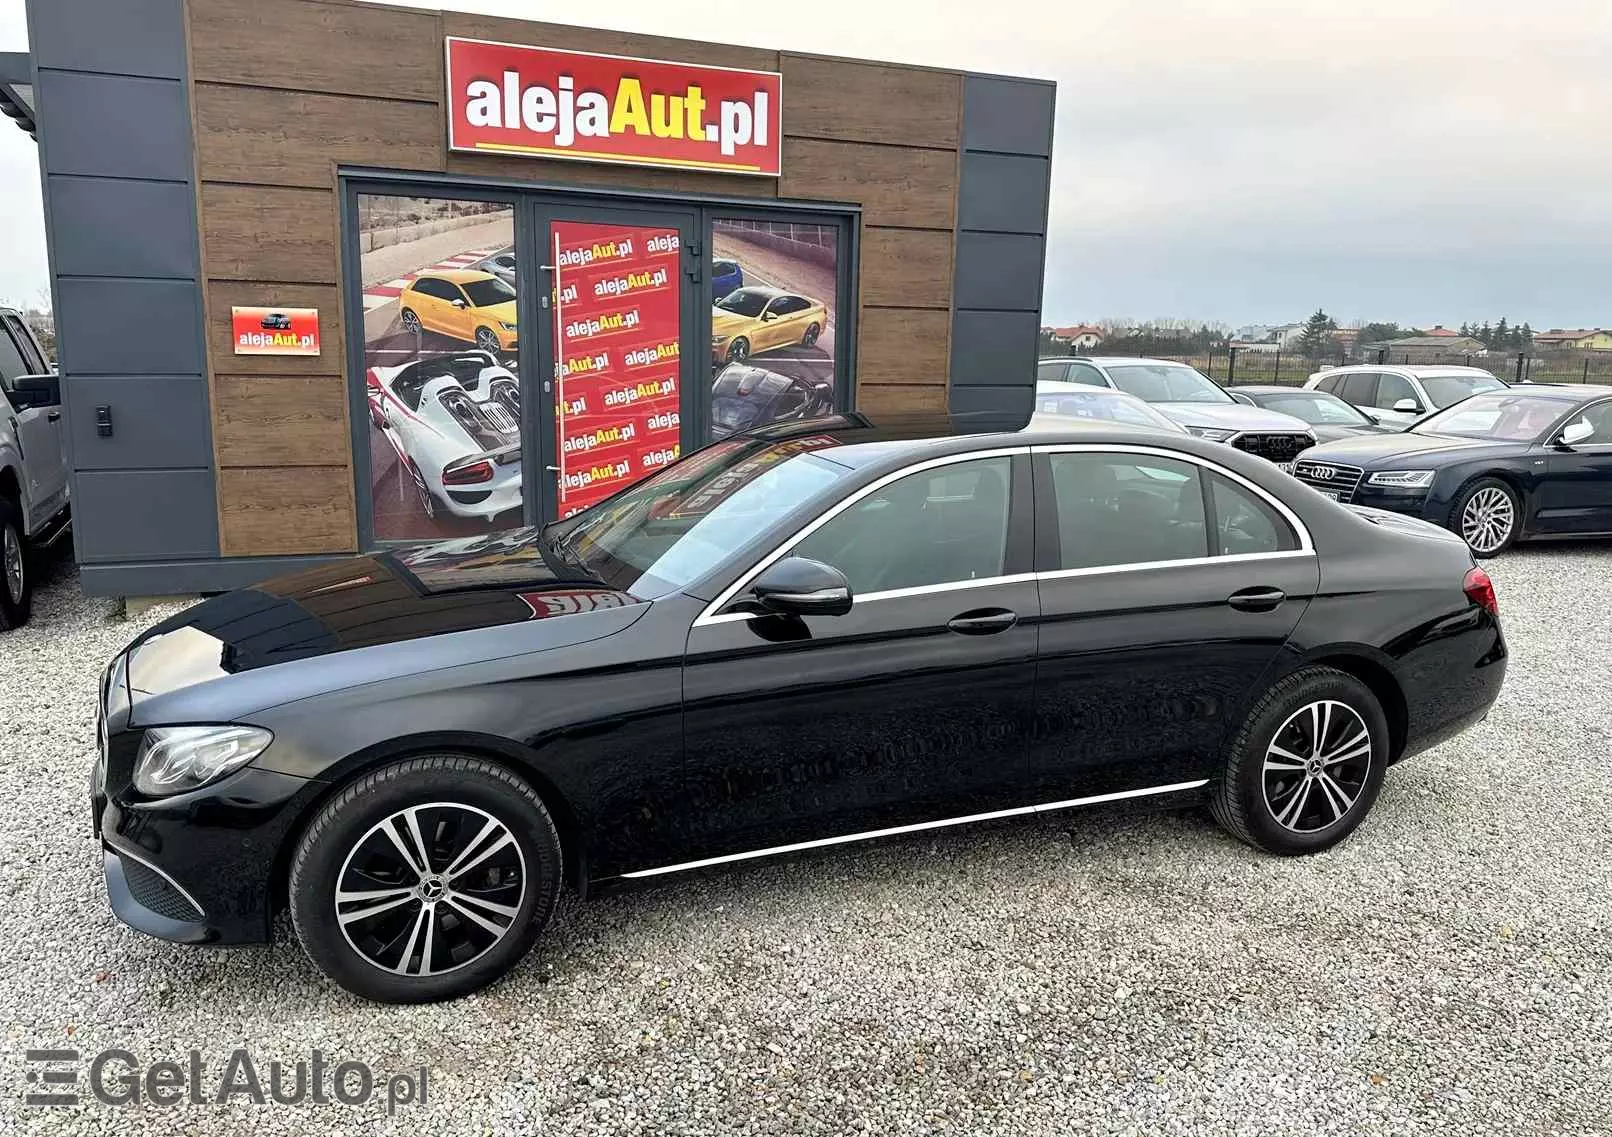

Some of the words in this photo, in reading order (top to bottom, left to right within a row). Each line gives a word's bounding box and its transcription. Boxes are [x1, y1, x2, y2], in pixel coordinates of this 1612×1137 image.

[465, 69, 769, 156] alejaAut.pl
[560, 239, 633, 265] alejaAut.pl
[594, 268, 668, 295] alejaAut.pl
[566, 309, 641, 337] alejaAut.pl
[239, 332, 315, 349] alejaAut.pl
[604, 377, 676, 406] alejaAut.pl
[564, 423, 636, 453] alejaAut.pl
